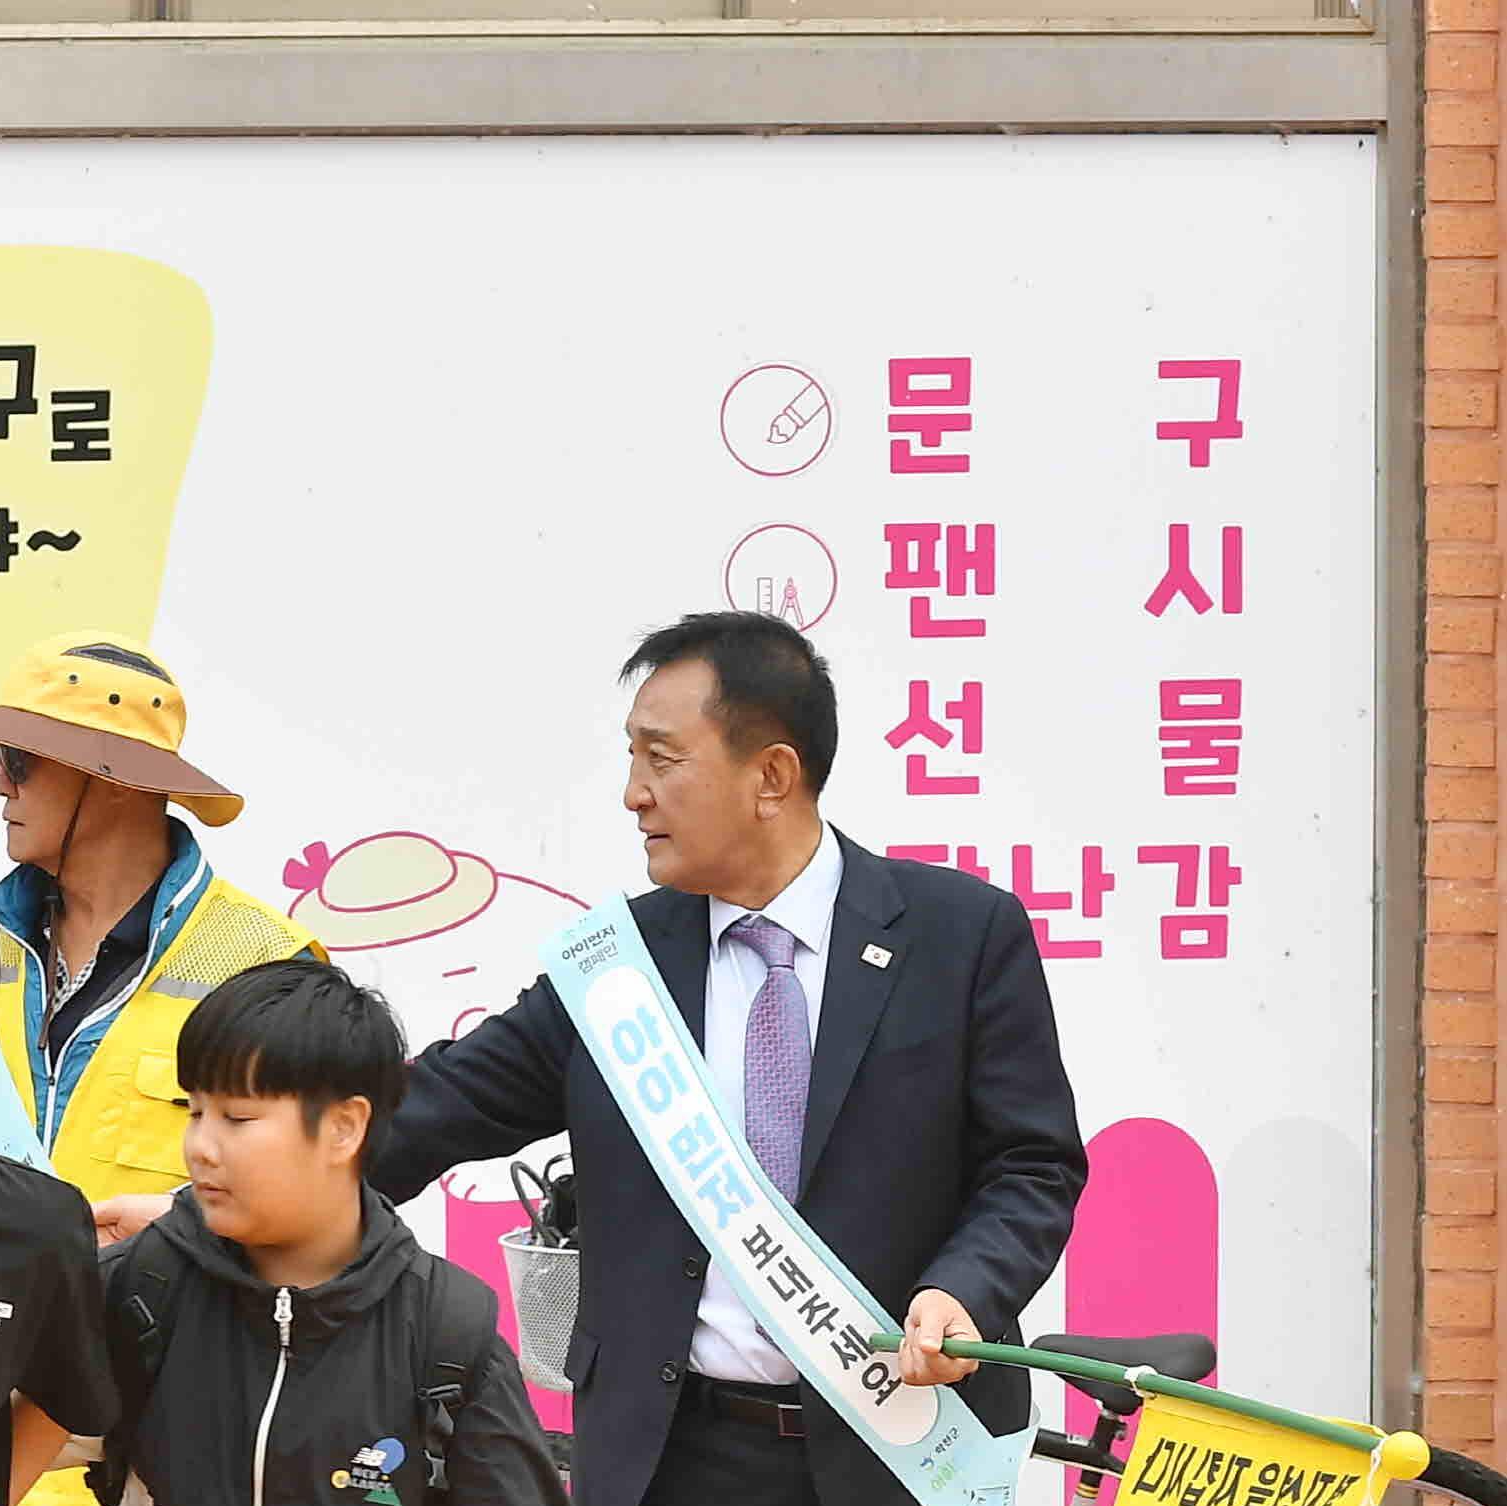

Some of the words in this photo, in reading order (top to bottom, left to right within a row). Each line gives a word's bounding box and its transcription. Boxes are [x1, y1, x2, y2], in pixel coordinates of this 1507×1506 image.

[561, 923, 617, 962] 아이먼저
[885, 844, 1244, 960] 난감
[610, 1005, 690, 1114] 아이
[666, 1123, 755, 1231] 먼저
[741, 1223, 903, 1408] 보내주세요
